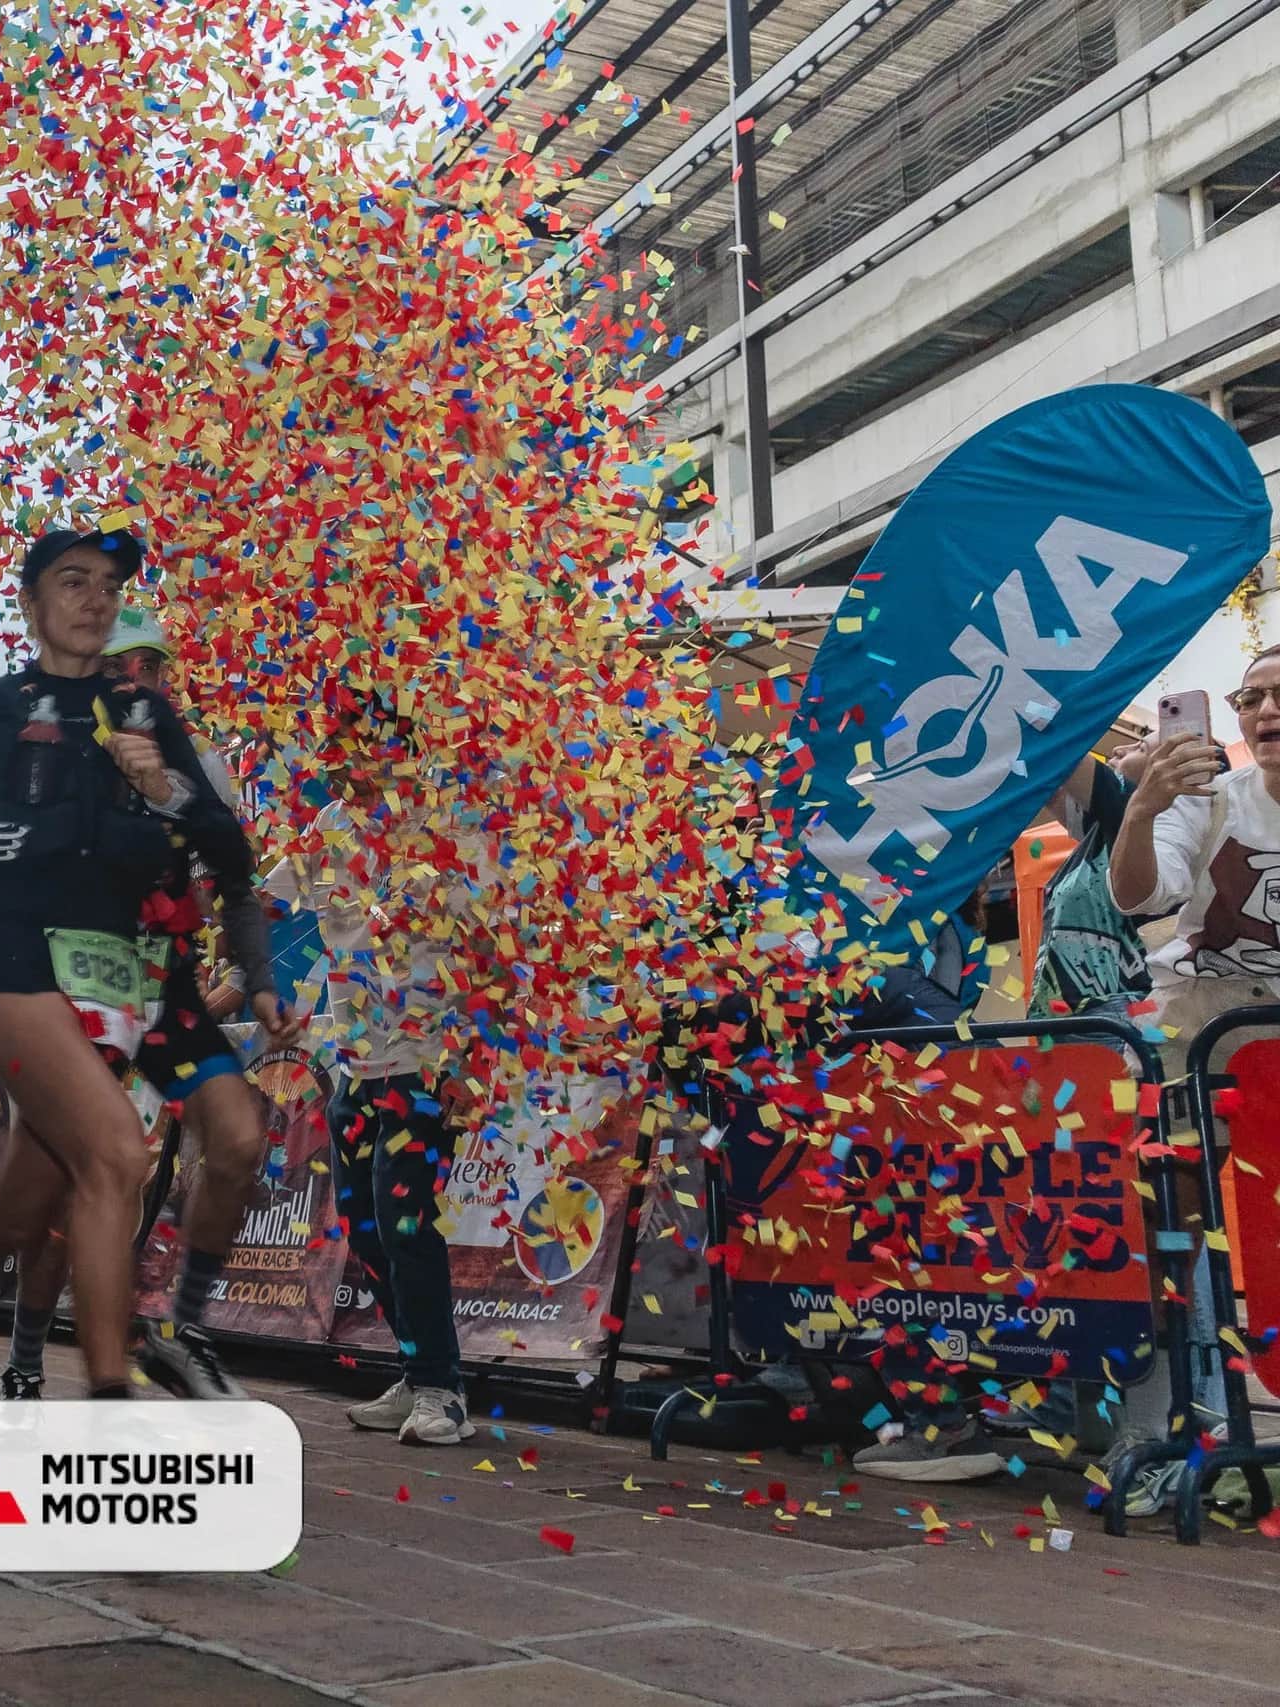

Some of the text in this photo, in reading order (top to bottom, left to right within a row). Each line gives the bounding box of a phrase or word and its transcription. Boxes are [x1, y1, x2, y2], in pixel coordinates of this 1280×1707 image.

[801, 515, 1189, 916] HOKA
[841, 1141, 1124, 1198] PEOPLE
[228, 1251, 293, 1268] NYON RACE
[453, 1299, 563, 1321] MOCHARACE
[789, 1290, 1076, 1327] ww.peopleplays.com
